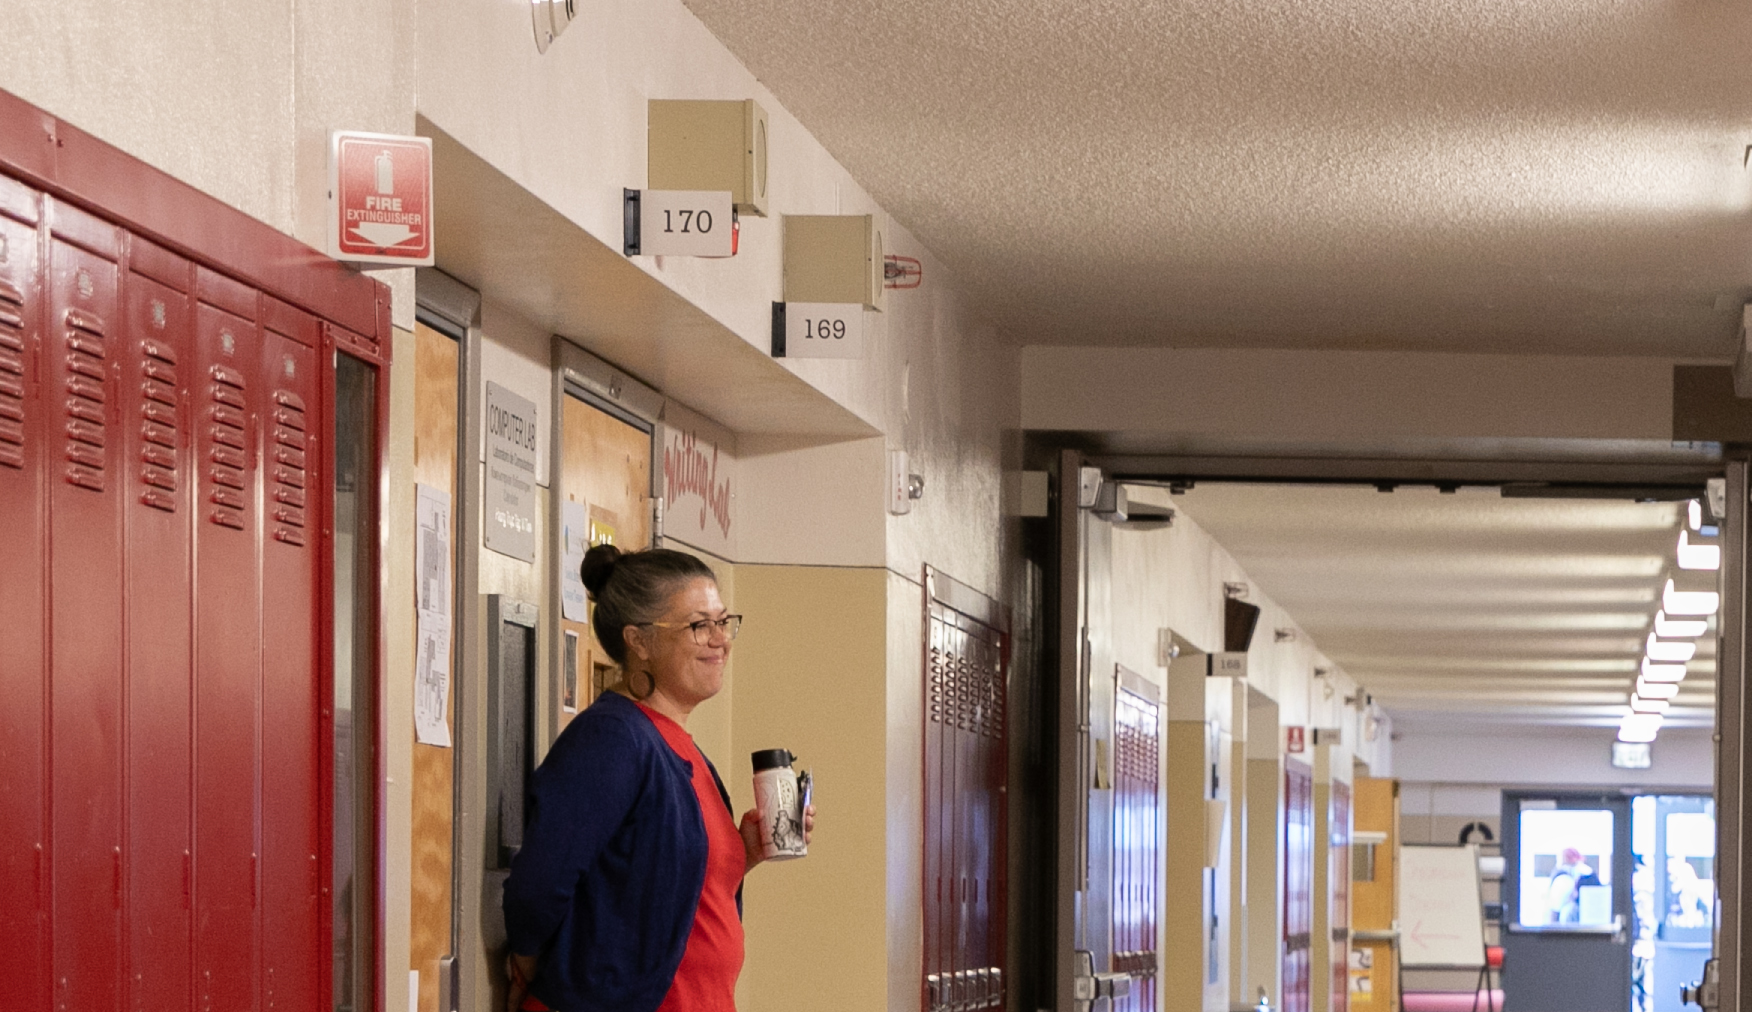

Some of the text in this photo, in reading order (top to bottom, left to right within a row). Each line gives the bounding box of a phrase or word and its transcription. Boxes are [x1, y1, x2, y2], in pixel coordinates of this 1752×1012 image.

[366, 196, 403, 212] FIRE
[346, 208, 422, 226] EXTINGUISHER
[663, 209, 713, 234] 170
[805, 318, 846, 340] 169
[489, 403, 536, 452] COMPUTER LAB
